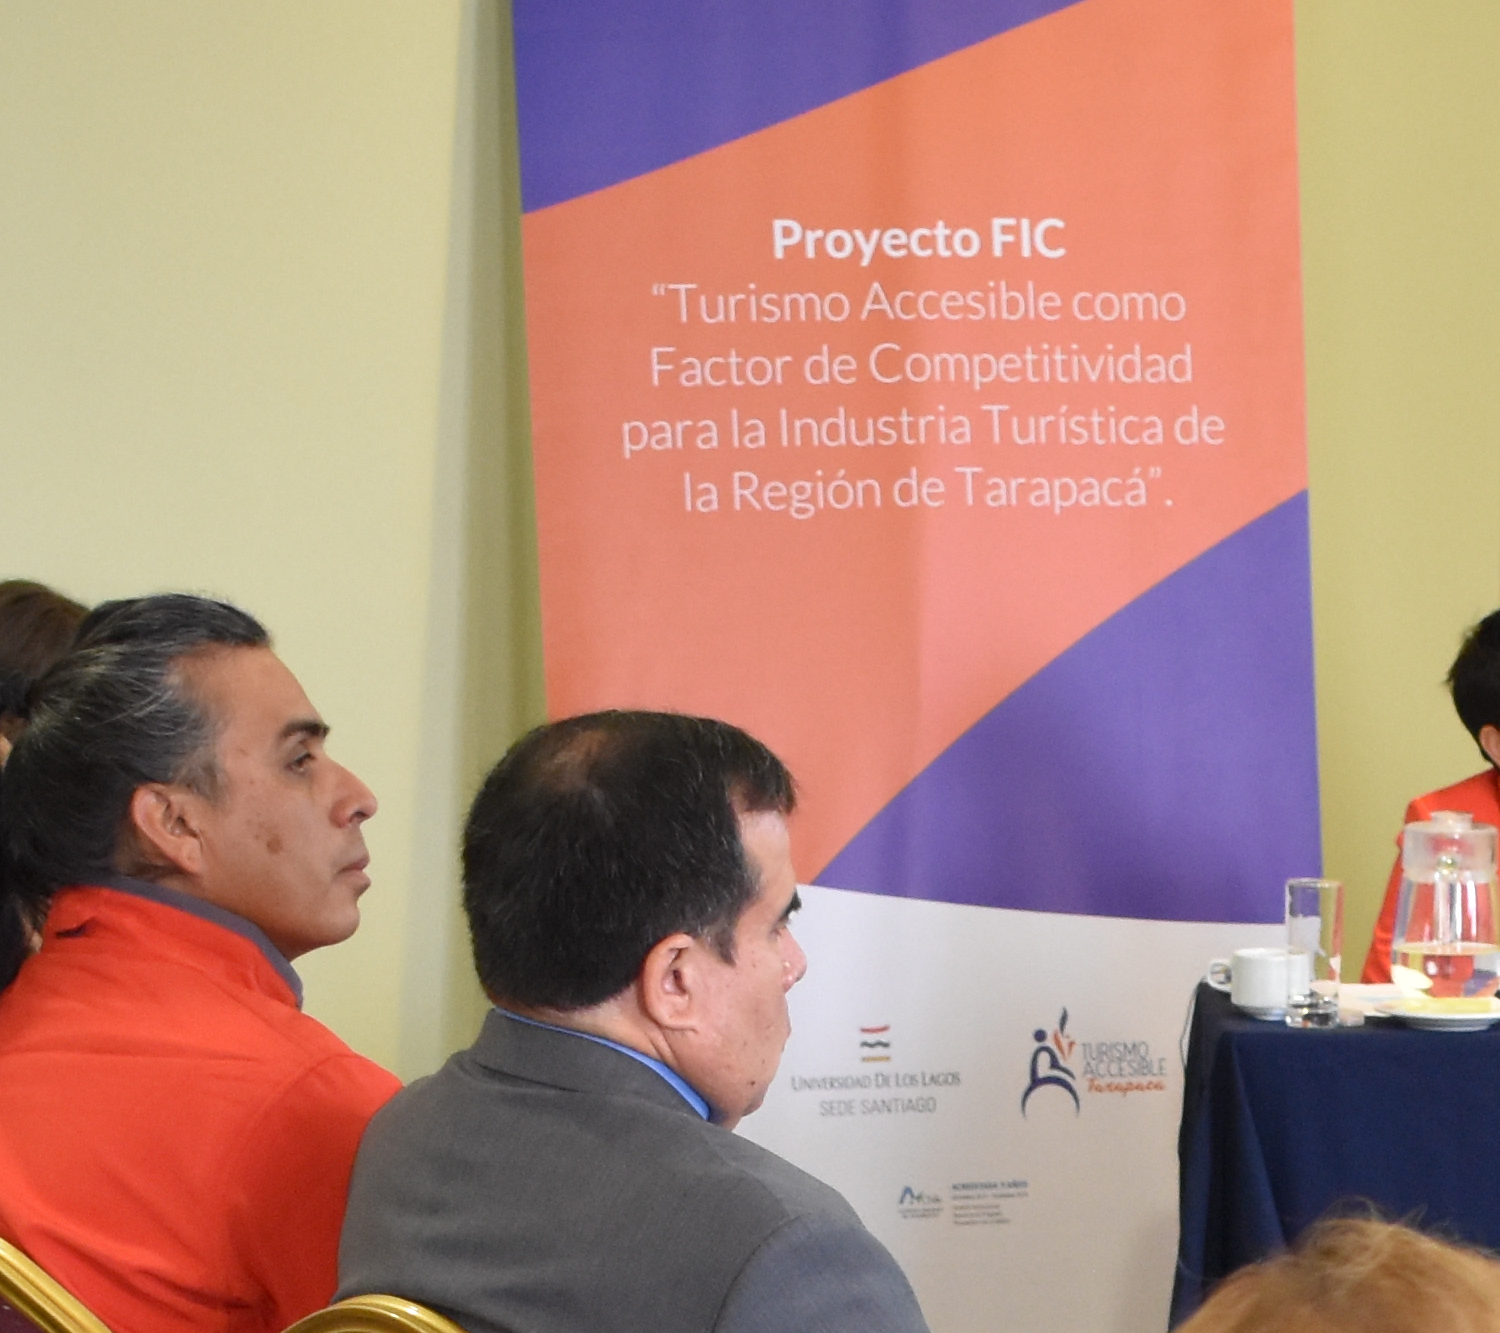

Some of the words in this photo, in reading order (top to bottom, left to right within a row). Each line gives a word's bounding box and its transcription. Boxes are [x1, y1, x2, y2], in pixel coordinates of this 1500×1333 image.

[772, 218, 981, 267] Proyecto
[991, 217, 1067, 259] FIC
[861, 280, 1062, 322] Accesible
[1072, 291, 1187, 322] como
[650, 346, 792, 387] Factor
[803, 344, 858, 385] de
[869, 342, 1193, 391] Competitividad
[622, 418, 719, 460] para
[731, 408, 767, 449] la
[780, 406, 972, 448] Industria
[980, 404, 1164, 446] Turística
[1174, 404, 1226, 445] de
[684, 471, 720, 513] la
[732, 469, 882, 520] Región
[893, 467, 946, 508] de
[1082, 1041, 1149, 1060] TURISMO
[1082, 1057, 1167, 1078] ACCESIBLE
[819, 1099, 854, 1116] SEDE
[861, 1097, 937, 1115] SANTIAGO
